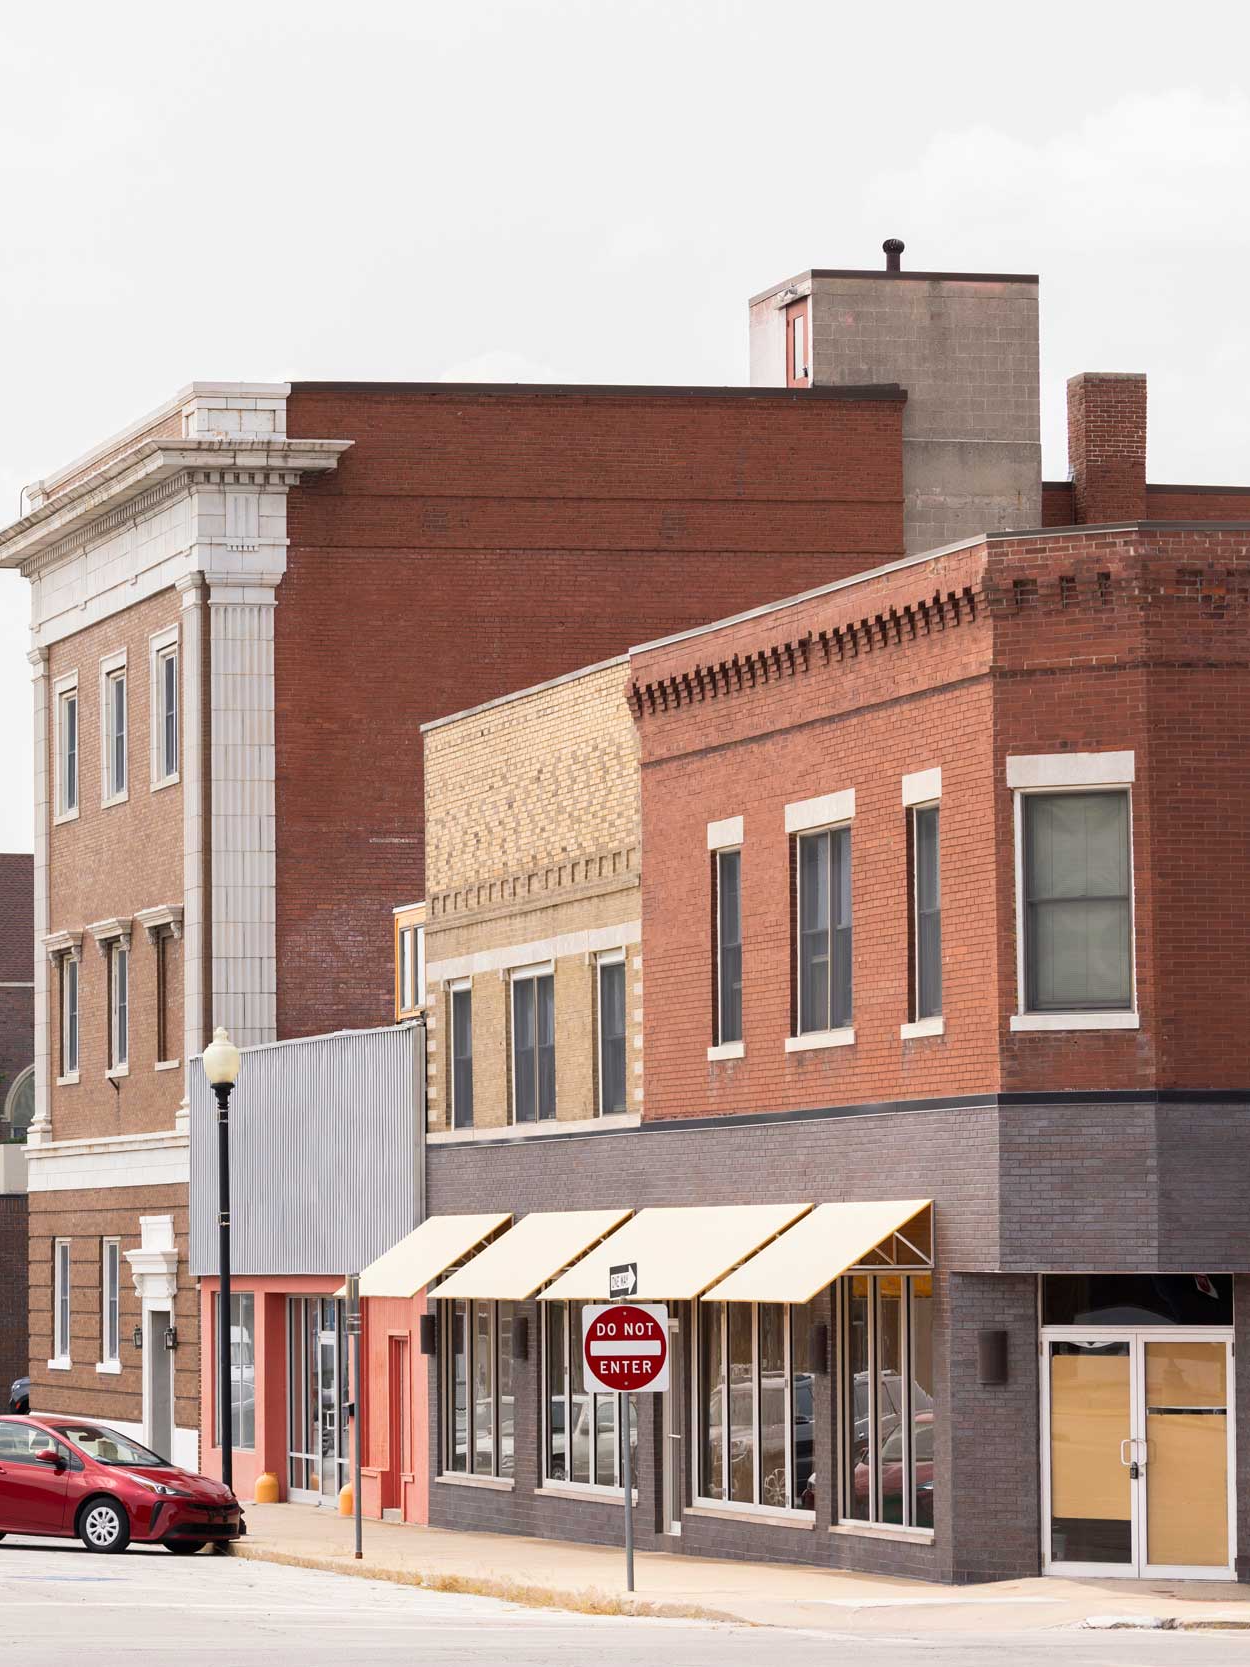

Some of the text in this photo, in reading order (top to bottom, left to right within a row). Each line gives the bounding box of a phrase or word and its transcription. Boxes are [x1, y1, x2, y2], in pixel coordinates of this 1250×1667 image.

[596, 1322, 654, 1336] DO NOT
[600, 1360, 652, 1374] ENTER
